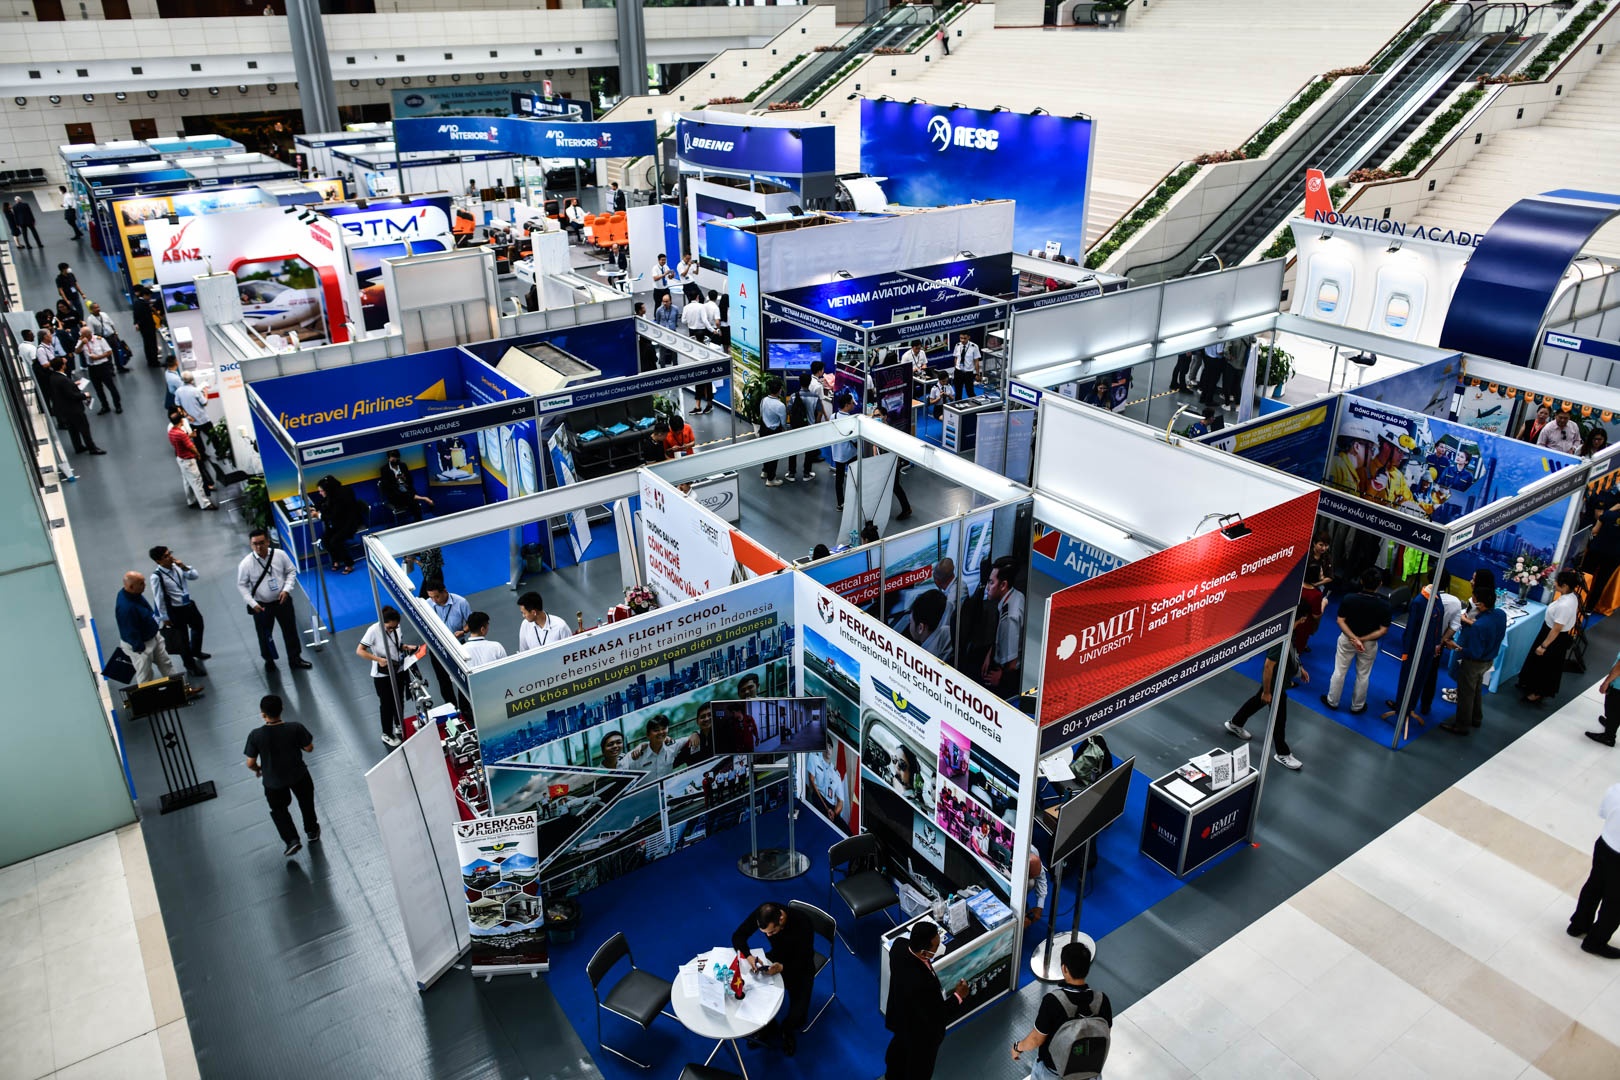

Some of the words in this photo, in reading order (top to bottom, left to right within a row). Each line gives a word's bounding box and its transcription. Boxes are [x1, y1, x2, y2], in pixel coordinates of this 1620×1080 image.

[438, 124, 457, 133] AVIO
[450, 131, 489, 140] INTERIORS
[546, 130, 564, 139] AVIO
[954, 125, 999, 151] AESC
[556, 138, 598, 147] INTERIORS
[692, 137, 734, 152] BOEING
[1313, 209, 1407, 236] NOVATION
[162, 247, 200, 264] ASNZ
[827, 291, 871, 309] VIETNAM
[871, 283, 916, 301] AVIATION
[916, 275, 961, 293] ACADEMY
[1033, 297, 1056, 307] VIETNAM
[1056, 292, 1081, 304] AVIATION
[1080, 288, 1102, 299] ACADEM
[781, 306, 801, 319] VIETNAM
[800, 312, 821, 325] AVIATION
[820, 319, 843, 332] ACADEMY
[897, 323, 924, 335] VIETNAM
[924, 317, 953, 331] AVIATION
[952, 312, 980, 326] ACADEMY
[576, 394, 589, 402] CTCP
[596, 389, 611, 399] THUẬT
[611, 386, 627, 395] CÔNG
[626, 383, 640, 393] NGHỆ
[640, 379, 655, 390] HÀNG
[655, 376, 672, 387] KHÔNG
[711, 366, 723, 374] A.36
[352, 394, 414, 420] Airlines
[1354, 406, 1370, 416] ĐỒNG
[1370, 410, 1386, 421] PHỤC
[1386, 415, 1399, 424] BẢO
[1398, 419, 1408, 427] HỘ
[400, 425, 433, 438] VIETRAVEL
[433, 420, 461, 432] AIRLINES
[511, 407, 526, 416] A.34
[1330, 500, 1348, 513] NHẬP
[1347, 506, 1365, 519] KHẨU
[1365, 512, 1379, 525] VIỆT
[1378, 518, 1402, 532] WORLD
[1412, 528, 1432, 543] A.44
[646, 519, 662, 537] TRƯỜNG
[662, 530, 670, 544] ĐẠI
[670, 536, 680, 551] HỌC
[647, 534, 664, 557] CÔNG
[664, 546, 681, 571] NGHỆ
[649, 554, 663, 574] GIAO
[664, 564, 684, 591] THÔNG
[904, 568, 931, 585] study
[1150, 590, 1186, 616] School
[1186, 583, 1199, 598] of
[1199, 570, 1239, 594] Science,
[1240, 545, 1295, 576] Engineering
[1147, 615, 1169, 632] and
[1169, 587, 1228, 622] Technology
[562, 638, 624, 665] PERKASA
[628, 621, 674, 643] FLIGHT
[678, 603, 728, 627] SCHOOL
[1078, 607, 1141, 654] RMIT
[504, 688, 514, 699] A
[519, 655, 616, 695] comprehensive
[620, 642, 654, 661] flight
[657, 626, 702, 648] training
[706, 620, 717, 630] in
[720, 602, 774, 626] Indonesia
[1079, 633, 1134, 665] UNIVERSITY
[511, 700, 536, 714] Một
[540, 686, 569, 703] khóa
[573, 674, 601, 692] huấn
[604, 662, 637, 682] Luyện
[640, 656, 660, 672] bay
[663, 645, 687, 662] toàn
[690, 634, 713, 652] diện
[715, 632, 723, 643] ở
[725, 616, 774, 639] Indonesia
[839, 608, 894, 657] PERKASA
[896, 648, 943, 687] FLIGHT
[945, 679, 1003, 729] SCHOOL
[839, 626, 891, 669] International
[891, 659, 912, 683] Pilot
[912, 676, 943, 704] School
[943, 698, 953, 710] in
[954, 703, 1002, 743] Indonesia
[1061, 718, 1084, 737] 80+
[1083, 704, 1114, 728] years
[1115, 698, 1128, 711] in
[1127, 673, 1179, 703] aerospace
[1179, 664, 1199, 681] and
[1199, 647, 1238, 670] aviation
[1238, 622, 1283, 651] education
[475, 815, 535, 831] PERKASA
[476, 828, 503, 836] FLIGHT
[504, 823, 536, 832] SCHOOL
[1158, 825, 1179, 843] RMIT
[1210, 822, 1235, 840] UNIVERSITY
[1211, 809, 1240, 834] RMIT
